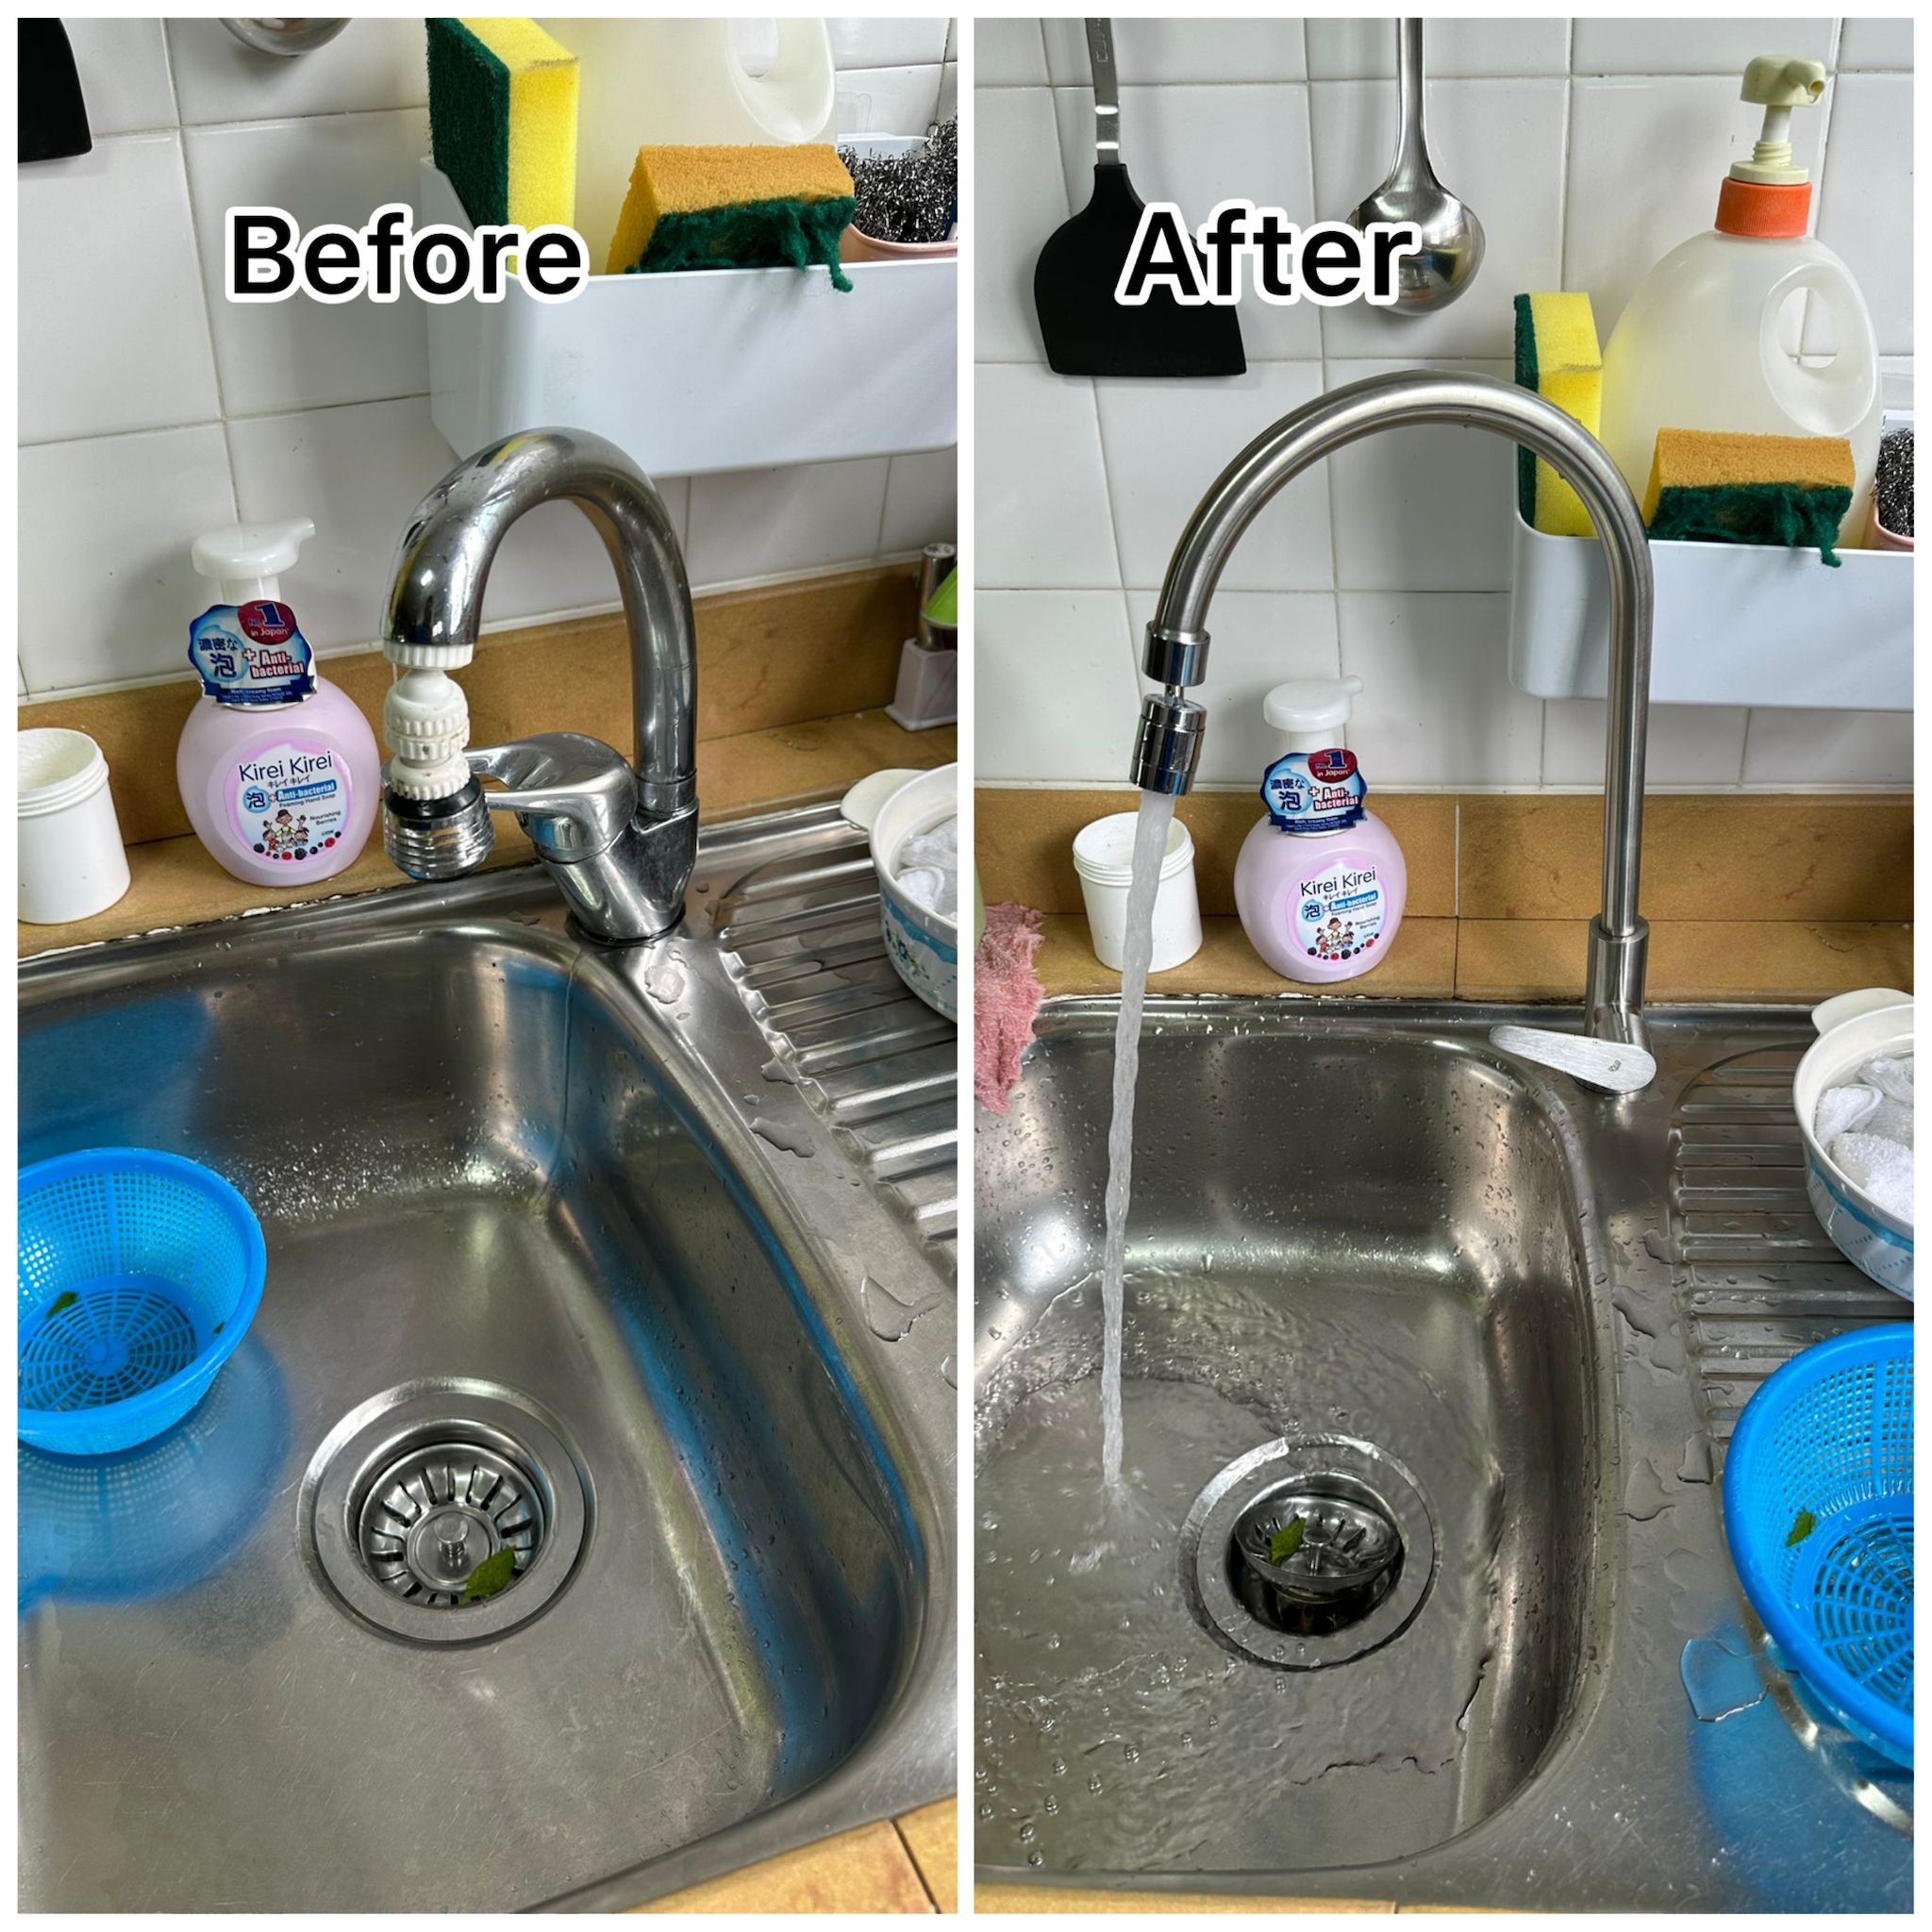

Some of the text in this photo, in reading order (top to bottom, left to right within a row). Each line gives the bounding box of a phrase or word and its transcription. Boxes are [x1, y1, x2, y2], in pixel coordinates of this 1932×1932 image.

[260, 626, 288, 637] Japan
[198, 638, 238, 651] 濃密な
[210, 653, 237, 677] 泡
[260, 650, 291, 665] Anti-
[251, 663, 304, 679] bacterial
[240, 751, 332, 782] Kirei Kirei
[247, 791, 265, 808] 泡
[277, 782, 335, 801] Anti-bacterial
[1323, 787, 1349, 800] Anti-
[1278, 791, 1301, 810] 泡
[1313, 796, 1358, 811] bacterial
[1301, 866, 1375, 896] Kirei Kirei
[1331, 892, 1376, 910] Anti-bacterial
[1305, 905, 1320, 918] 泡
